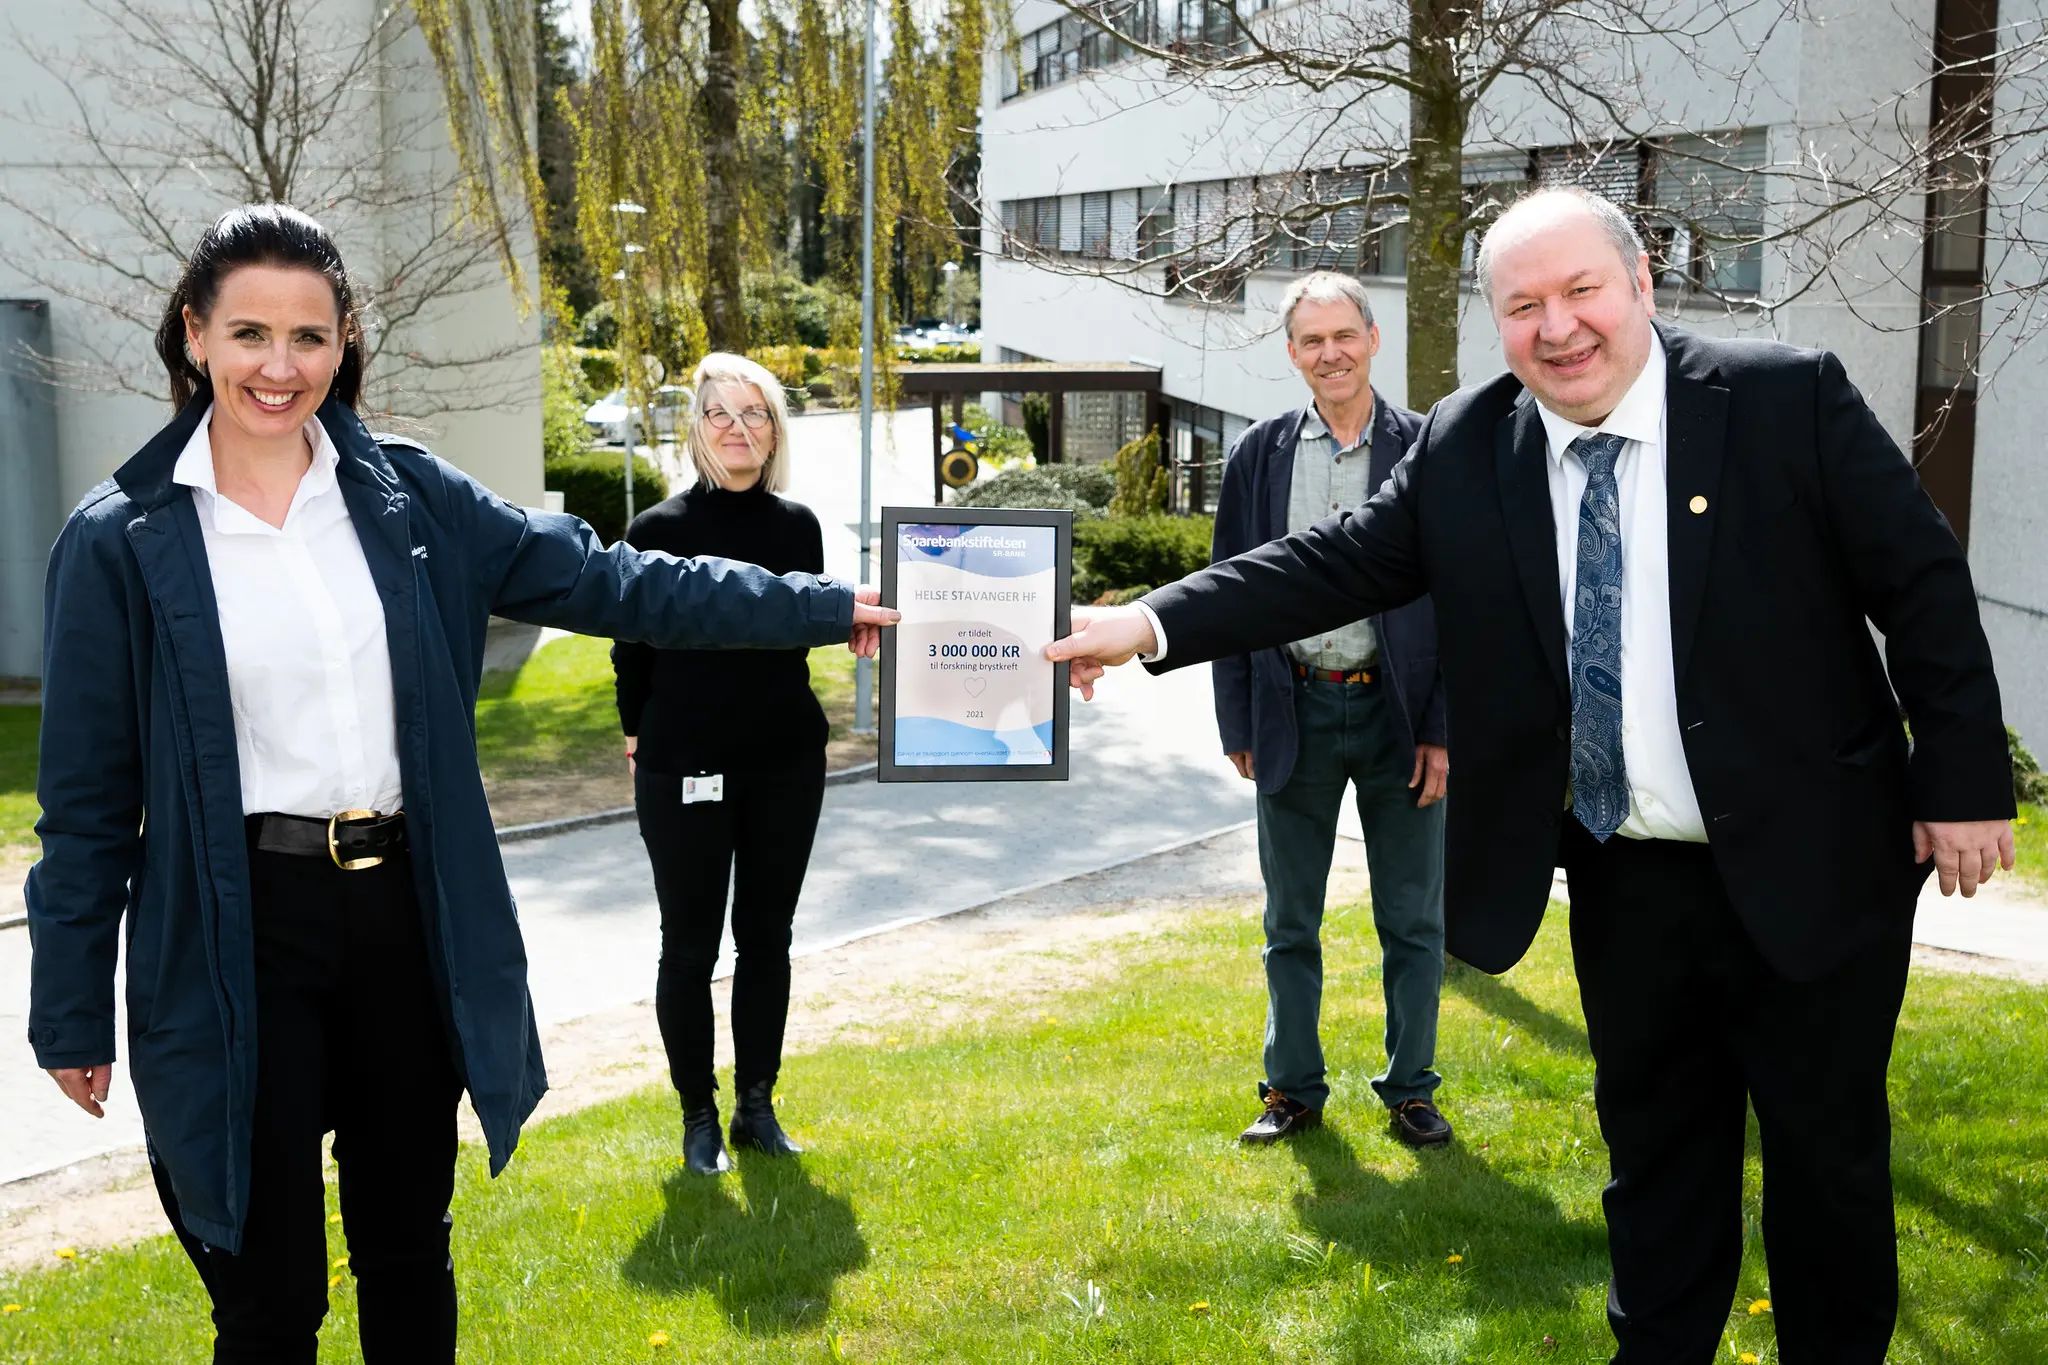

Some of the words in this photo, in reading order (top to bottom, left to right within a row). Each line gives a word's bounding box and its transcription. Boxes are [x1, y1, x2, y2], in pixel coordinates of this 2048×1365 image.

[903, 534, 1026, 550] Sparebankstiftelsen
[915, 590, 948, 600] HELSE
[951, 591, 1019, 602] STAVANGER
[1022, 592, 1037, 602] HF
[928, 645, 937, 657] 3
[941, 645, 967, 657] 000
[971, 645, 997, 657] 000
[1002, 645, 1020, 658] KR
[930, 662, 938, 670] til
[940, 662, 977, 672] forskning
[979, 662, 1018, 671] brystkreft
